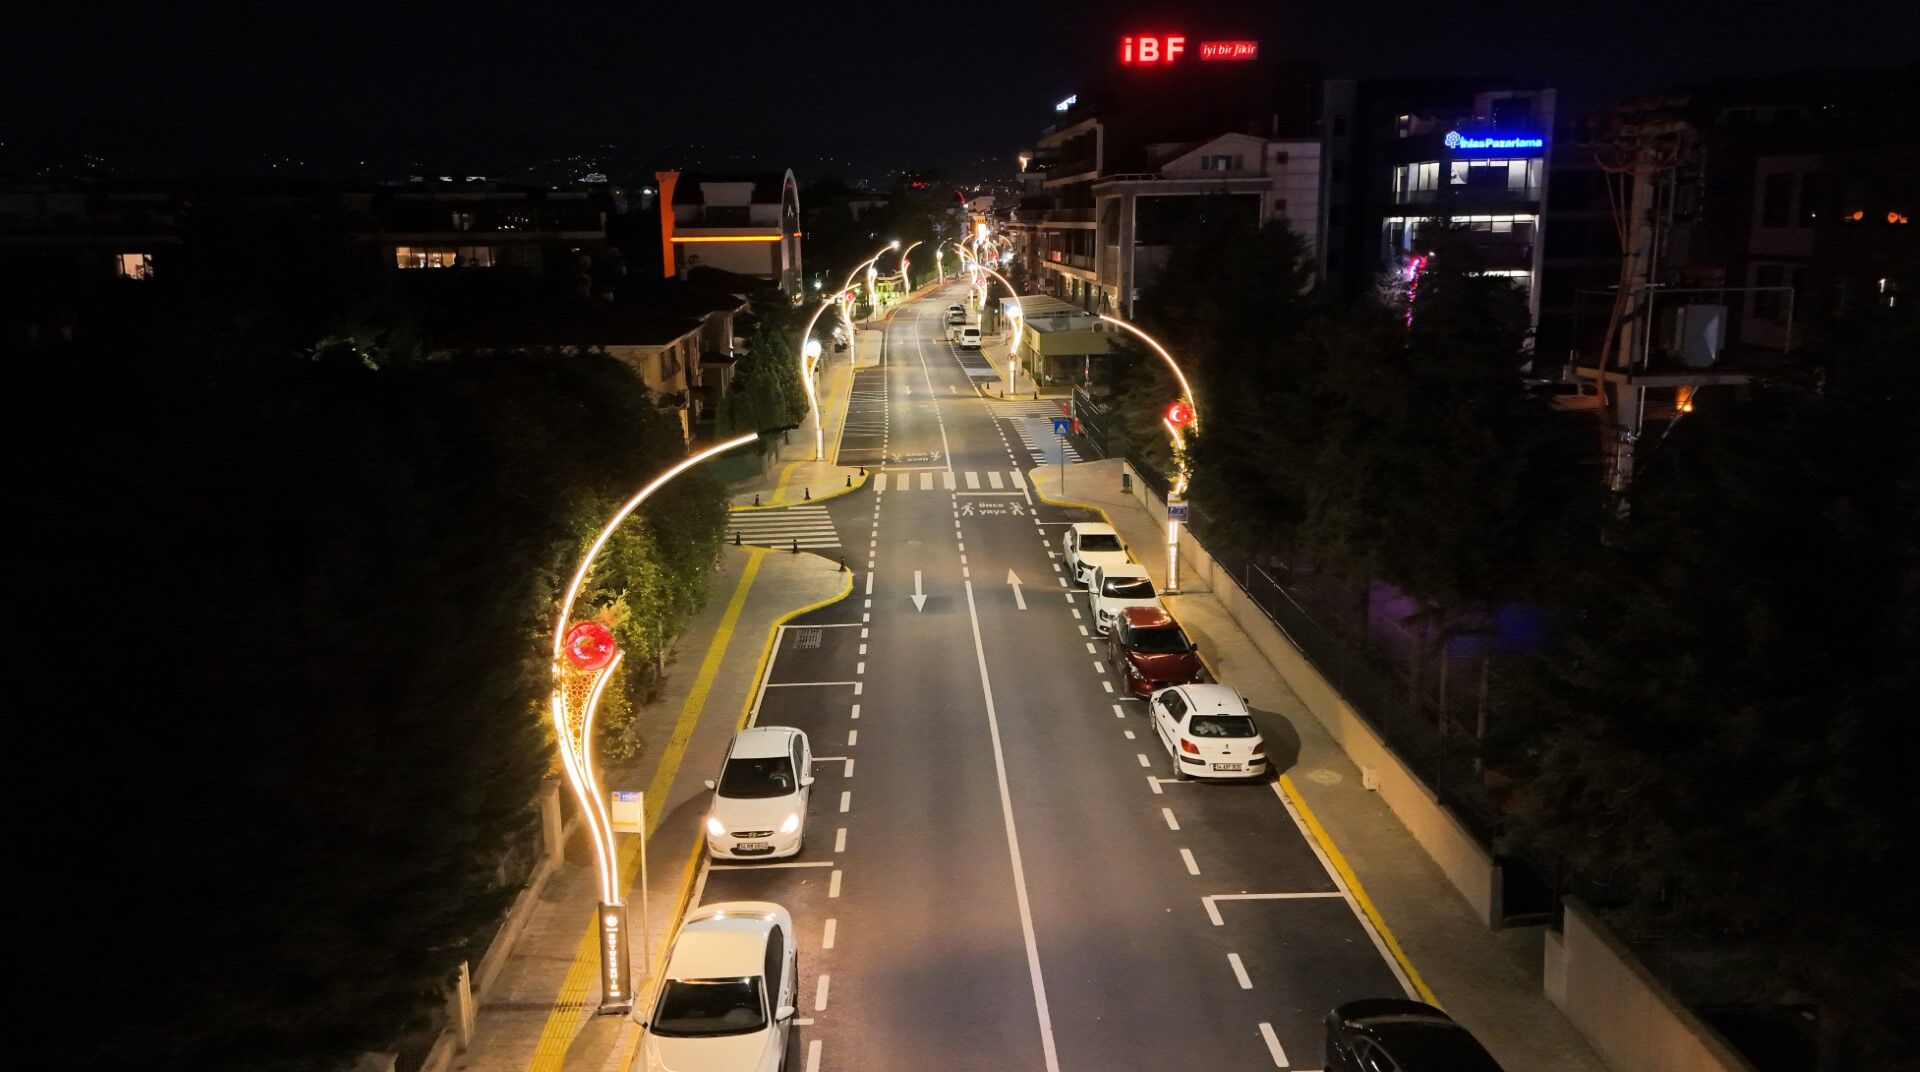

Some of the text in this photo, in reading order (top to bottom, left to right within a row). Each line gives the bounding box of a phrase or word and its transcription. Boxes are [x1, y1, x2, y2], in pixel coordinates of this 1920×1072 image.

[1203, 44, 1257, 57] iyi bir fikir
